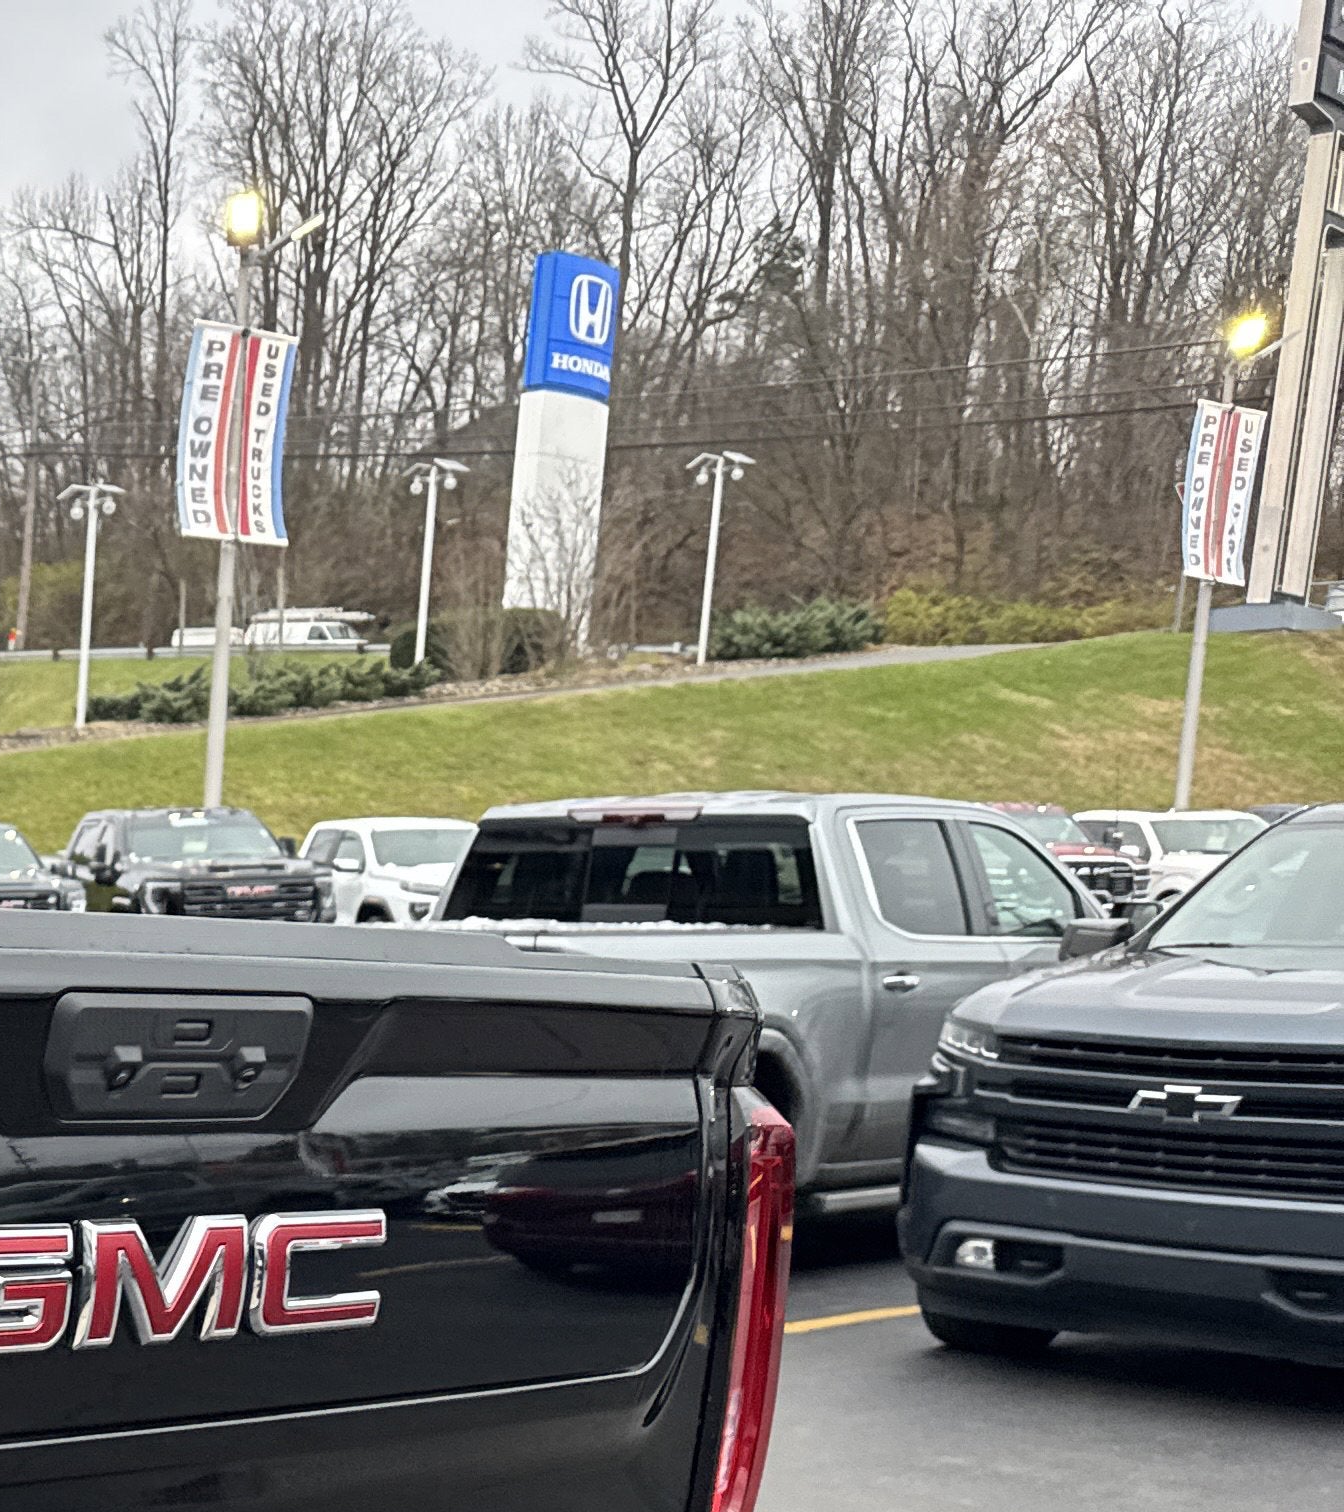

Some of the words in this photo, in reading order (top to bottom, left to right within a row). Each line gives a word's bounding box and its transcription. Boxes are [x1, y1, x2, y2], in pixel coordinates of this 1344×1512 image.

[200, 339, 226, 402] PRE
[256, 343, 280, 417] USED
[551, 351, 611, 382] HONDA
[189, 416, 213, 525] OWNED
[1197, 415, 1217, 466] PRE
[1234, 419, 1254, 491] USED
[250, 428, 267, 533] TRUCKS
